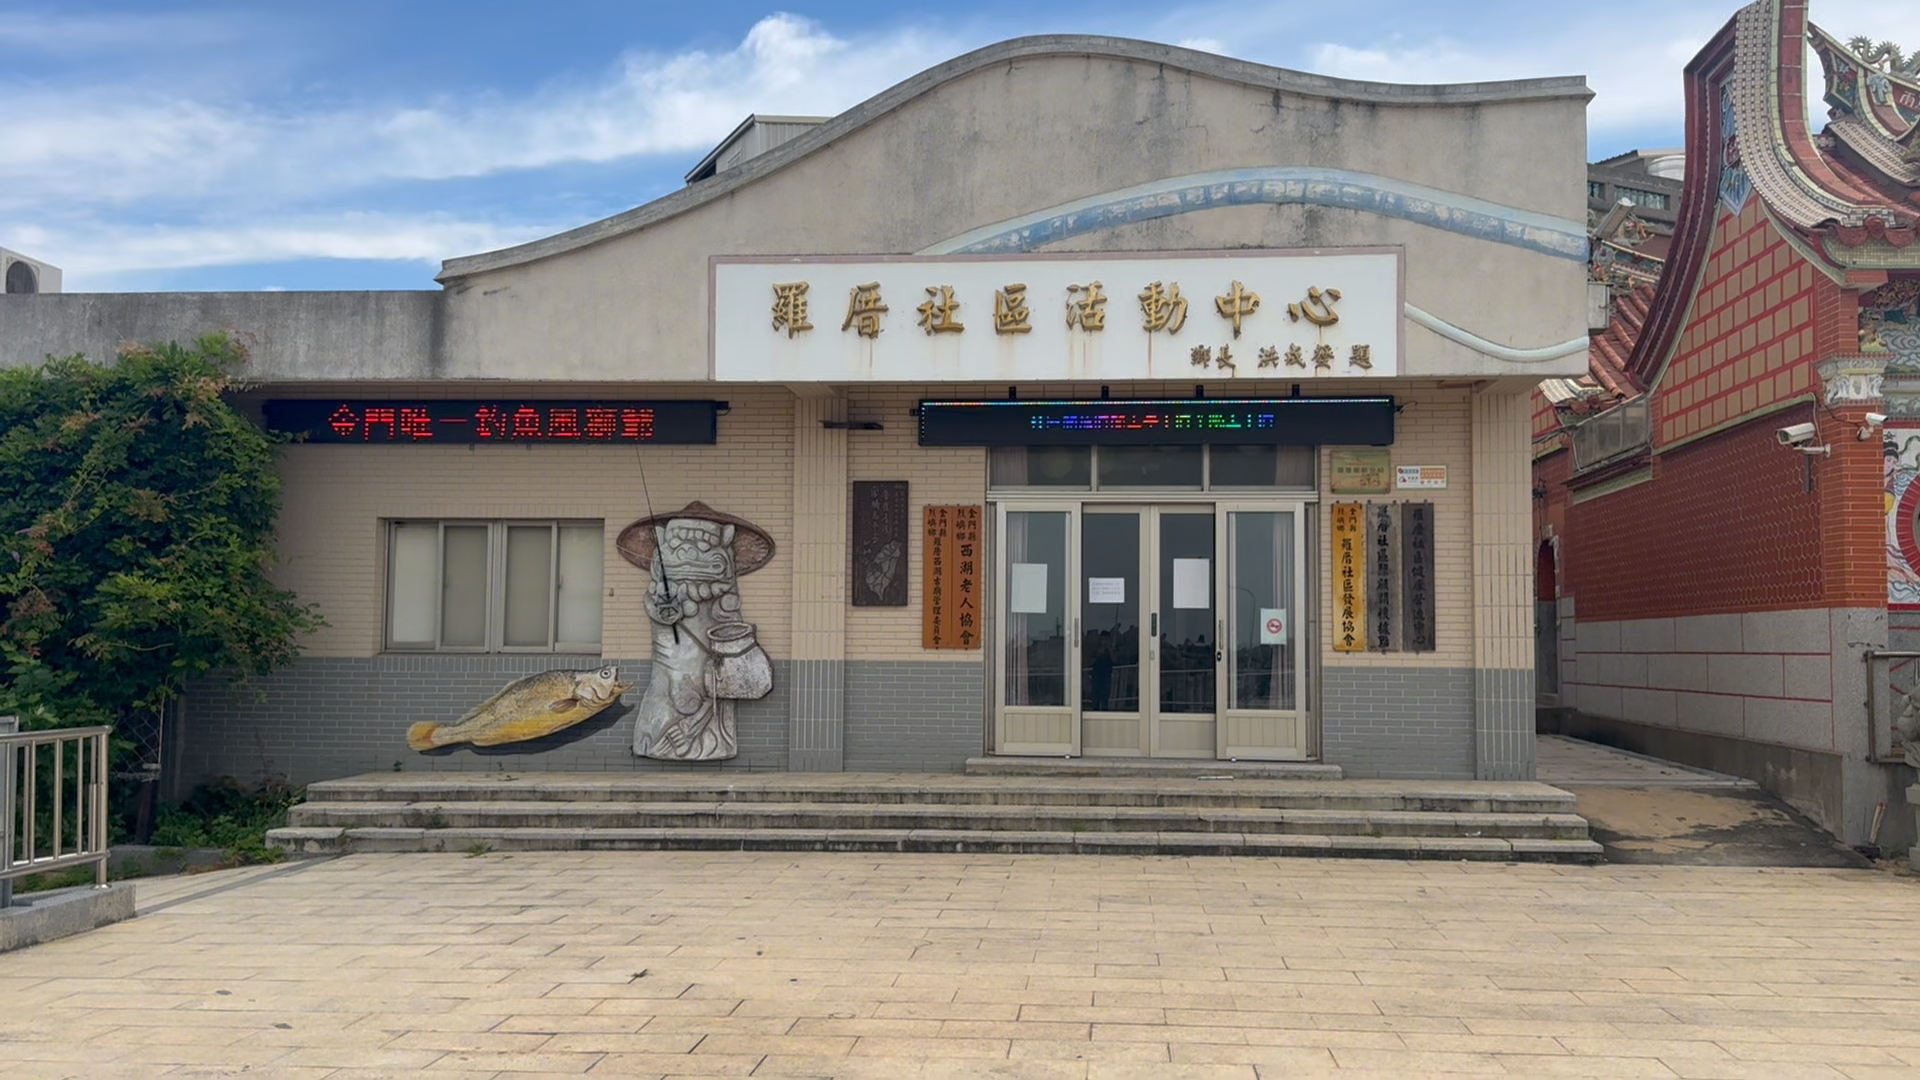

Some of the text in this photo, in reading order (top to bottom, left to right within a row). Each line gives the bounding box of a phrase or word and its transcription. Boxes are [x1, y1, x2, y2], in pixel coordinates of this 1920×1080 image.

[770, 280, 1342, 340] 羅厝社區活動中心
[960, 544, 974, 645] 西湖老人協會
[1341, 538, 1356, 647] 羅厝社區發展協會
